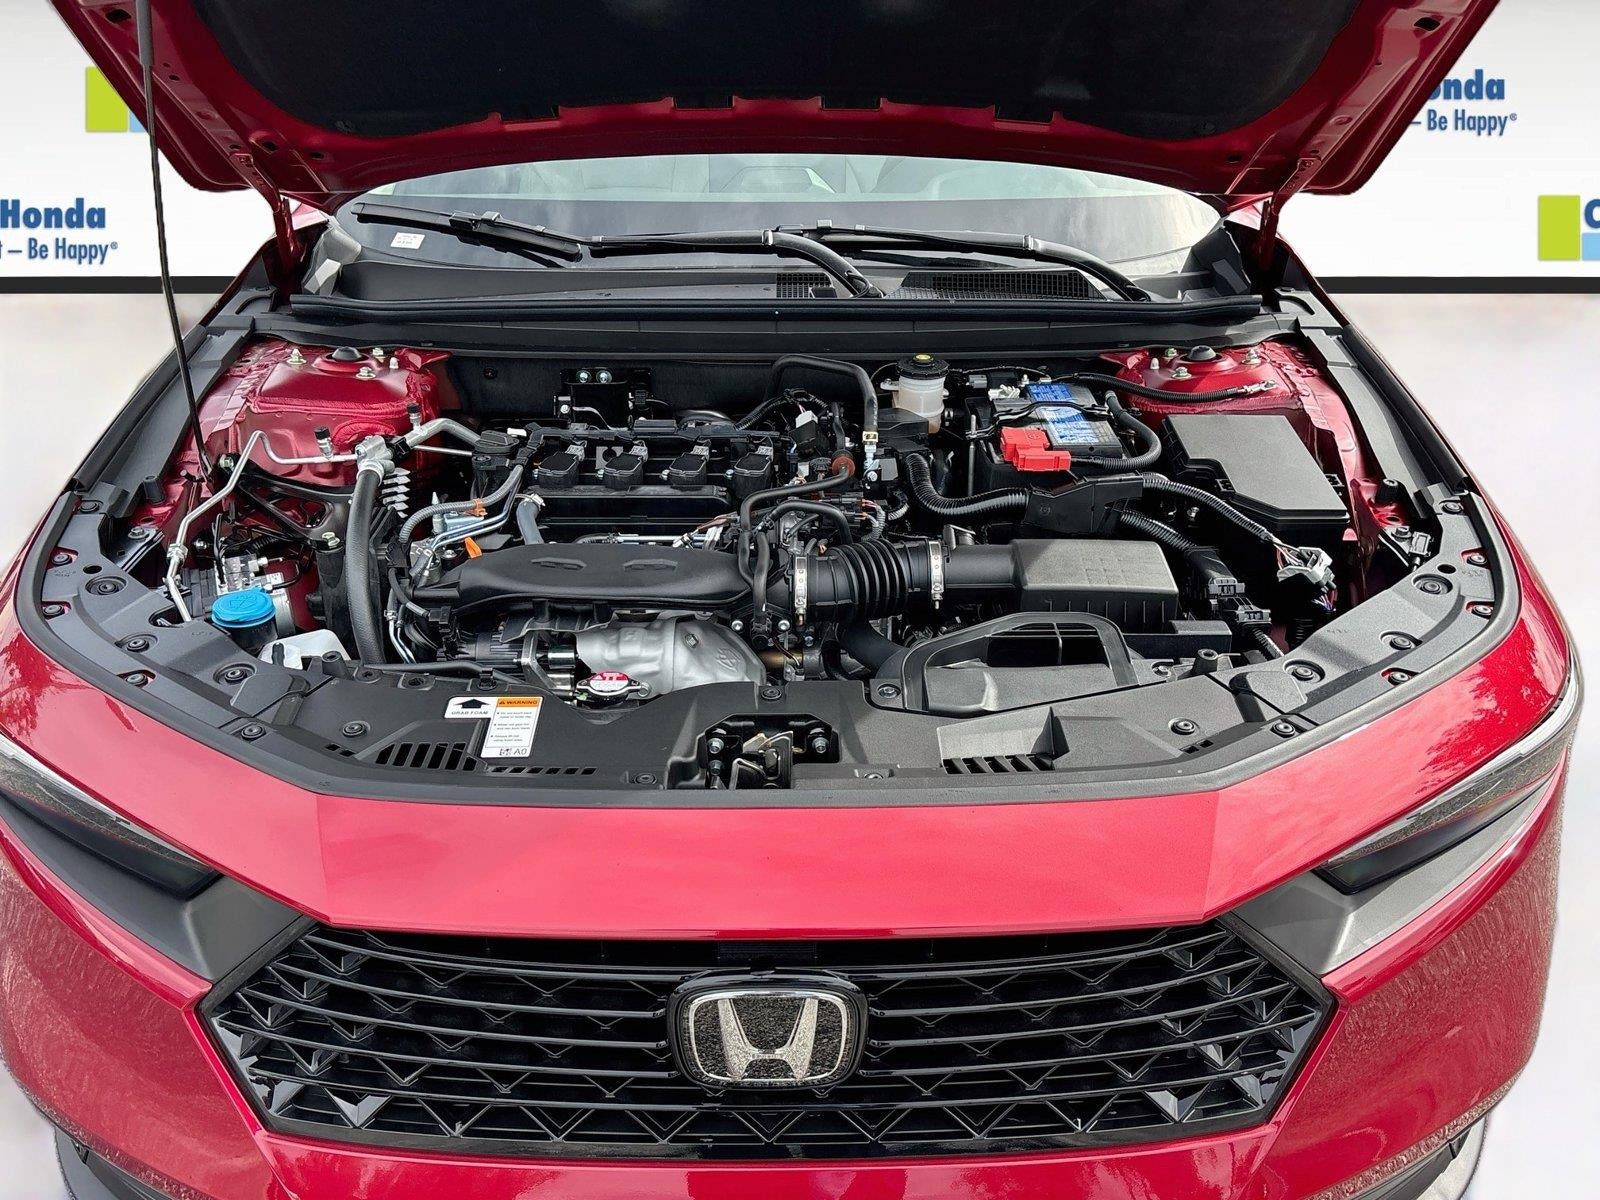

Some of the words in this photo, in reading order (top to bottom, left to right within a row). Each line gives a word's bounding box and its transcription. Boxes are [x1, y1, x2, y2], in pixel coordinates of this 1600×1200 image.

[1427, 109, 1448, 131] Be
[0, 197, 106, 229] Honda
[28, 237, 49, 259] Be
